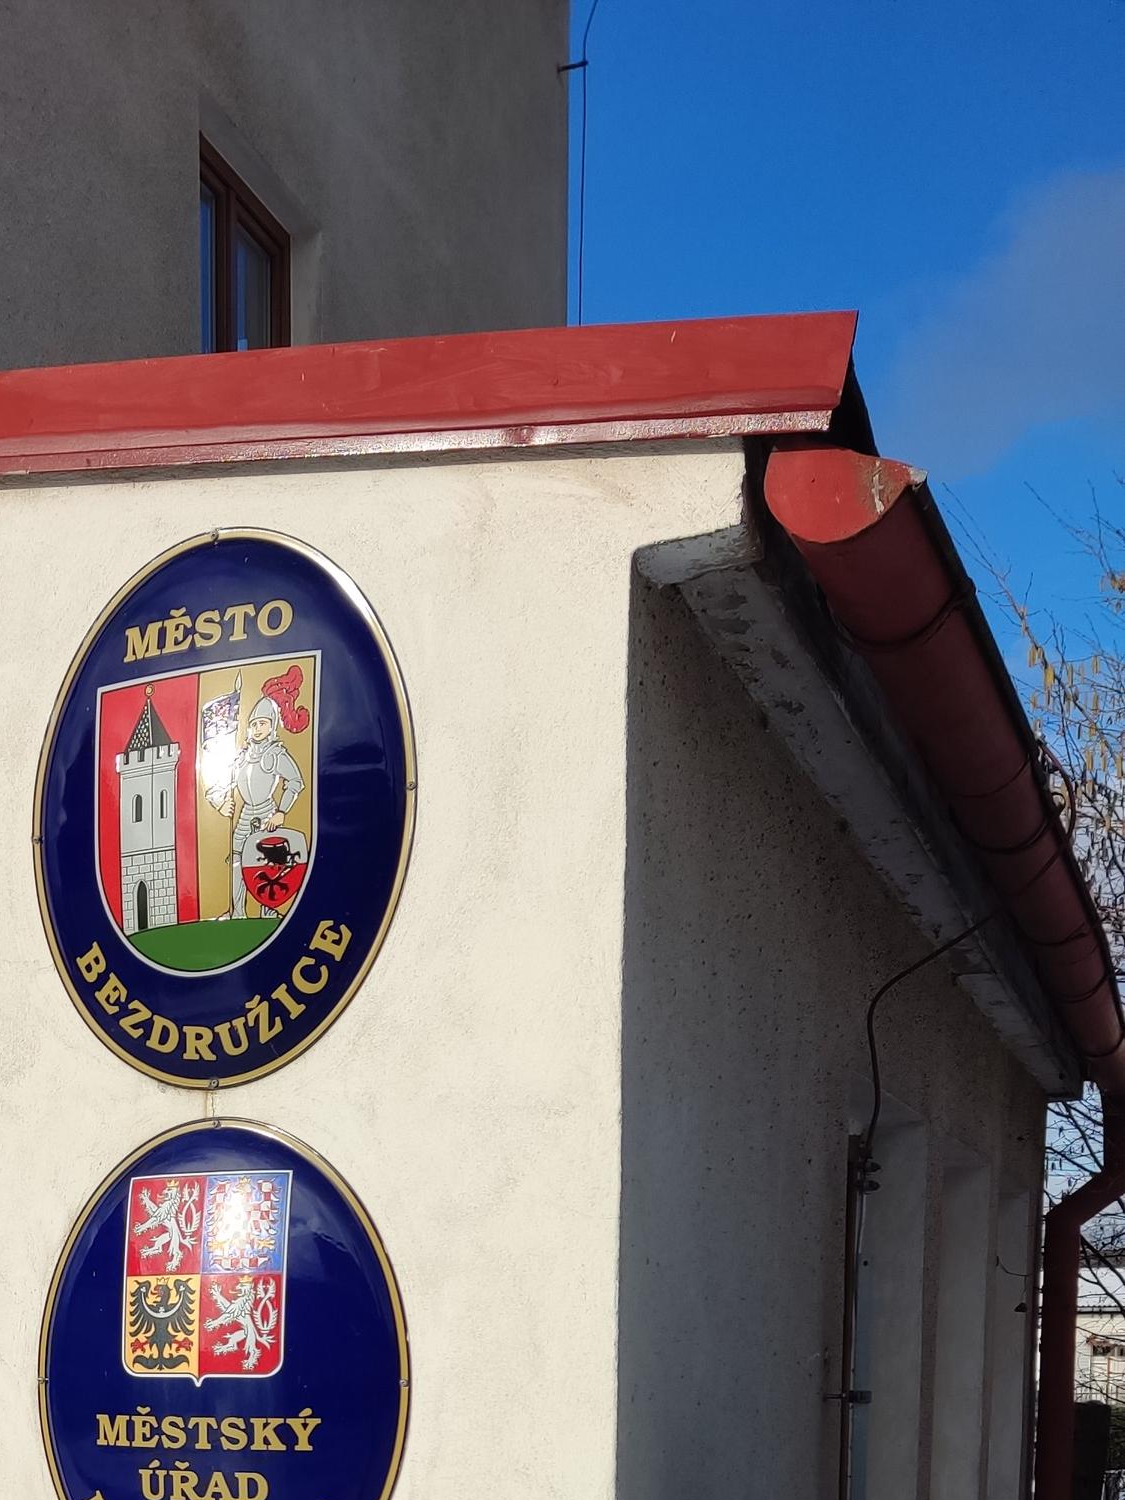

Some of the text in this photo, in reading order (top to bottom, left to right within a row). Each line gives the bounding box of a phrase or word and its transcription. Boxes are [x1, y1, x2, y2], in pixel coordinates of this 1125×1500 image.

[124, 600, 294, 662] MĚSTO
[77, 919, 353, 1061] BEZDRUŽICE
[96, 1406, 321, 1451] MĚSTSKÝ
